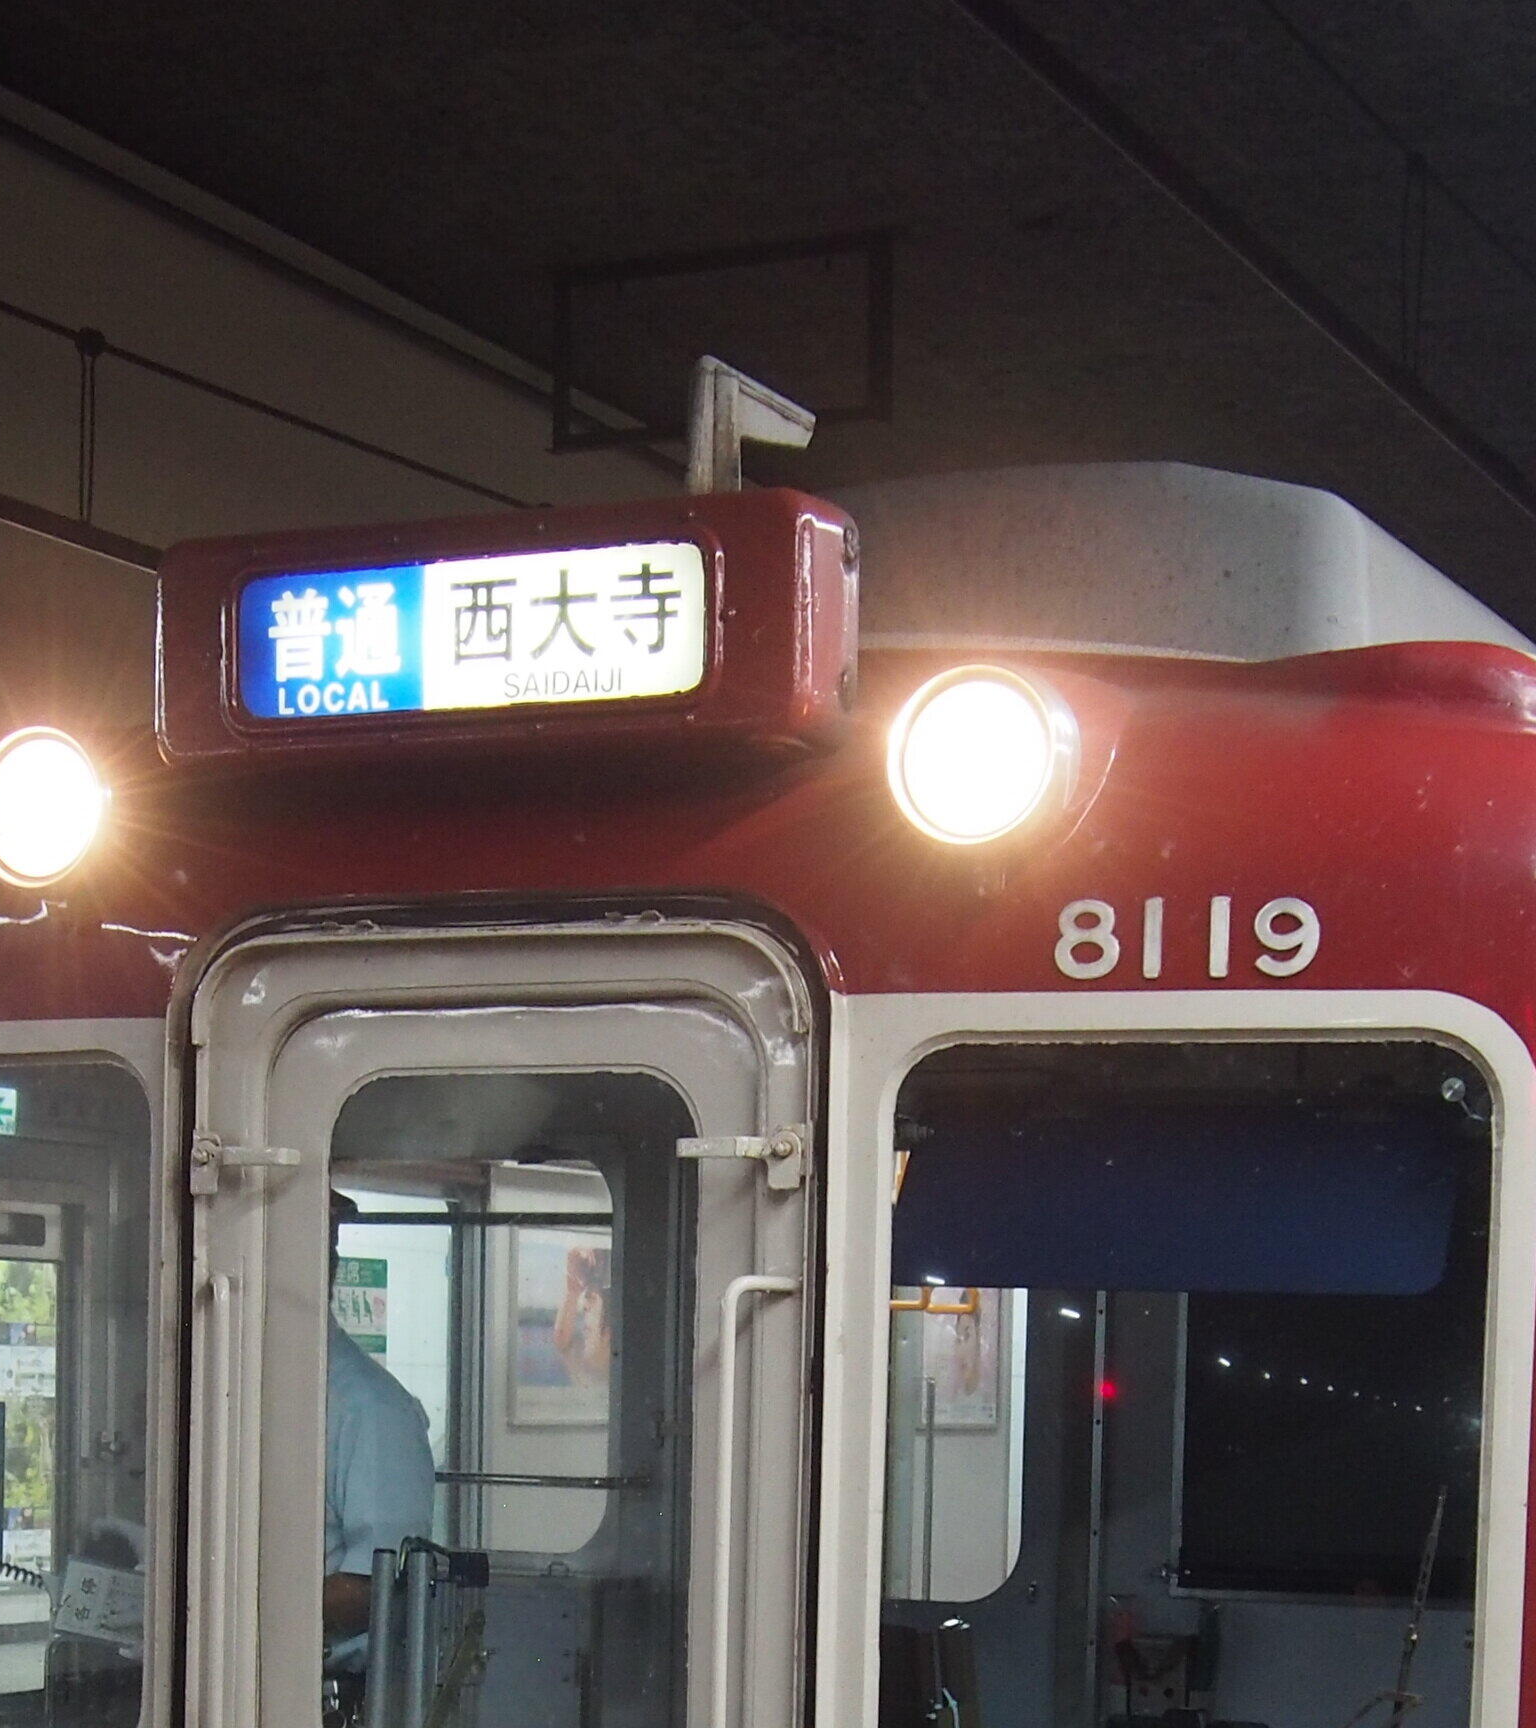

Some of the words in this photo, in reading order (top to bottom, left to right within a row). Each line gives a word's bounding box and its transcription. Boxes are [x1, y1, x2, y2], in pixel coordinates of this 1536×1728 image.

[268, 583, 402, 682] 普通
[450, 563, 682, 667] 西大寺
[277, 680, 389, 716] LOCAL
[503, 666, 623, 700] SAIDAIJI
[1053, 894, 1321, 981] 8119
